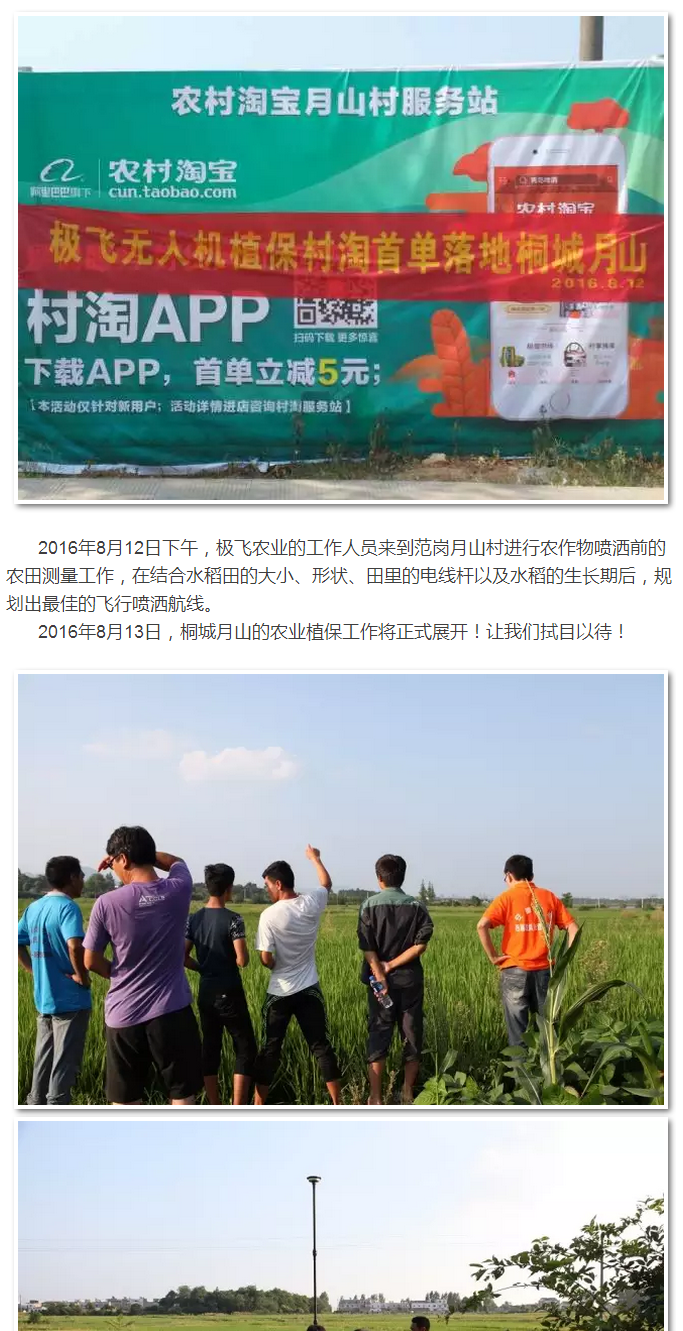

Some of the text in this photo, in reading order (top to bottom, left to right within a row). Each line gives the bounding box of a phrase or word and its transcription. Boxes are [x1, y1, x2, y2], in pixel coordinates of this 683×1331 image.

[171, 85, 498, 116] 农村淘宝月山村服务站
[108, 159, 238, 184] 农村淘宝
[108, 185, 237, 199] cun.taobao.com
[49, 219, 648, 276] 极飞无人机植保村淘首单落地桐城月山
[27, 289, 270, 344] 村淘APP
[294, 332, 379, 344] 扫码下载 更多惊喜
[38, 538, 665, 557] 2016年8月12日下午，极飞农业的工作人员来到范岗月山村进行农作物喷洒前的
[6, 566, 672, 585] 农田测量工作，在结合水稻田的大小、形状、田里的电线杆以及水稻的生长期后，规
[6, 595, 210, 612] 划出最佳的飞行喷洒航线。
[38, 623, 622, 641] 2016年8月13日，桐城月山的农业植保工作将正式展开！让我们拭目以待！
